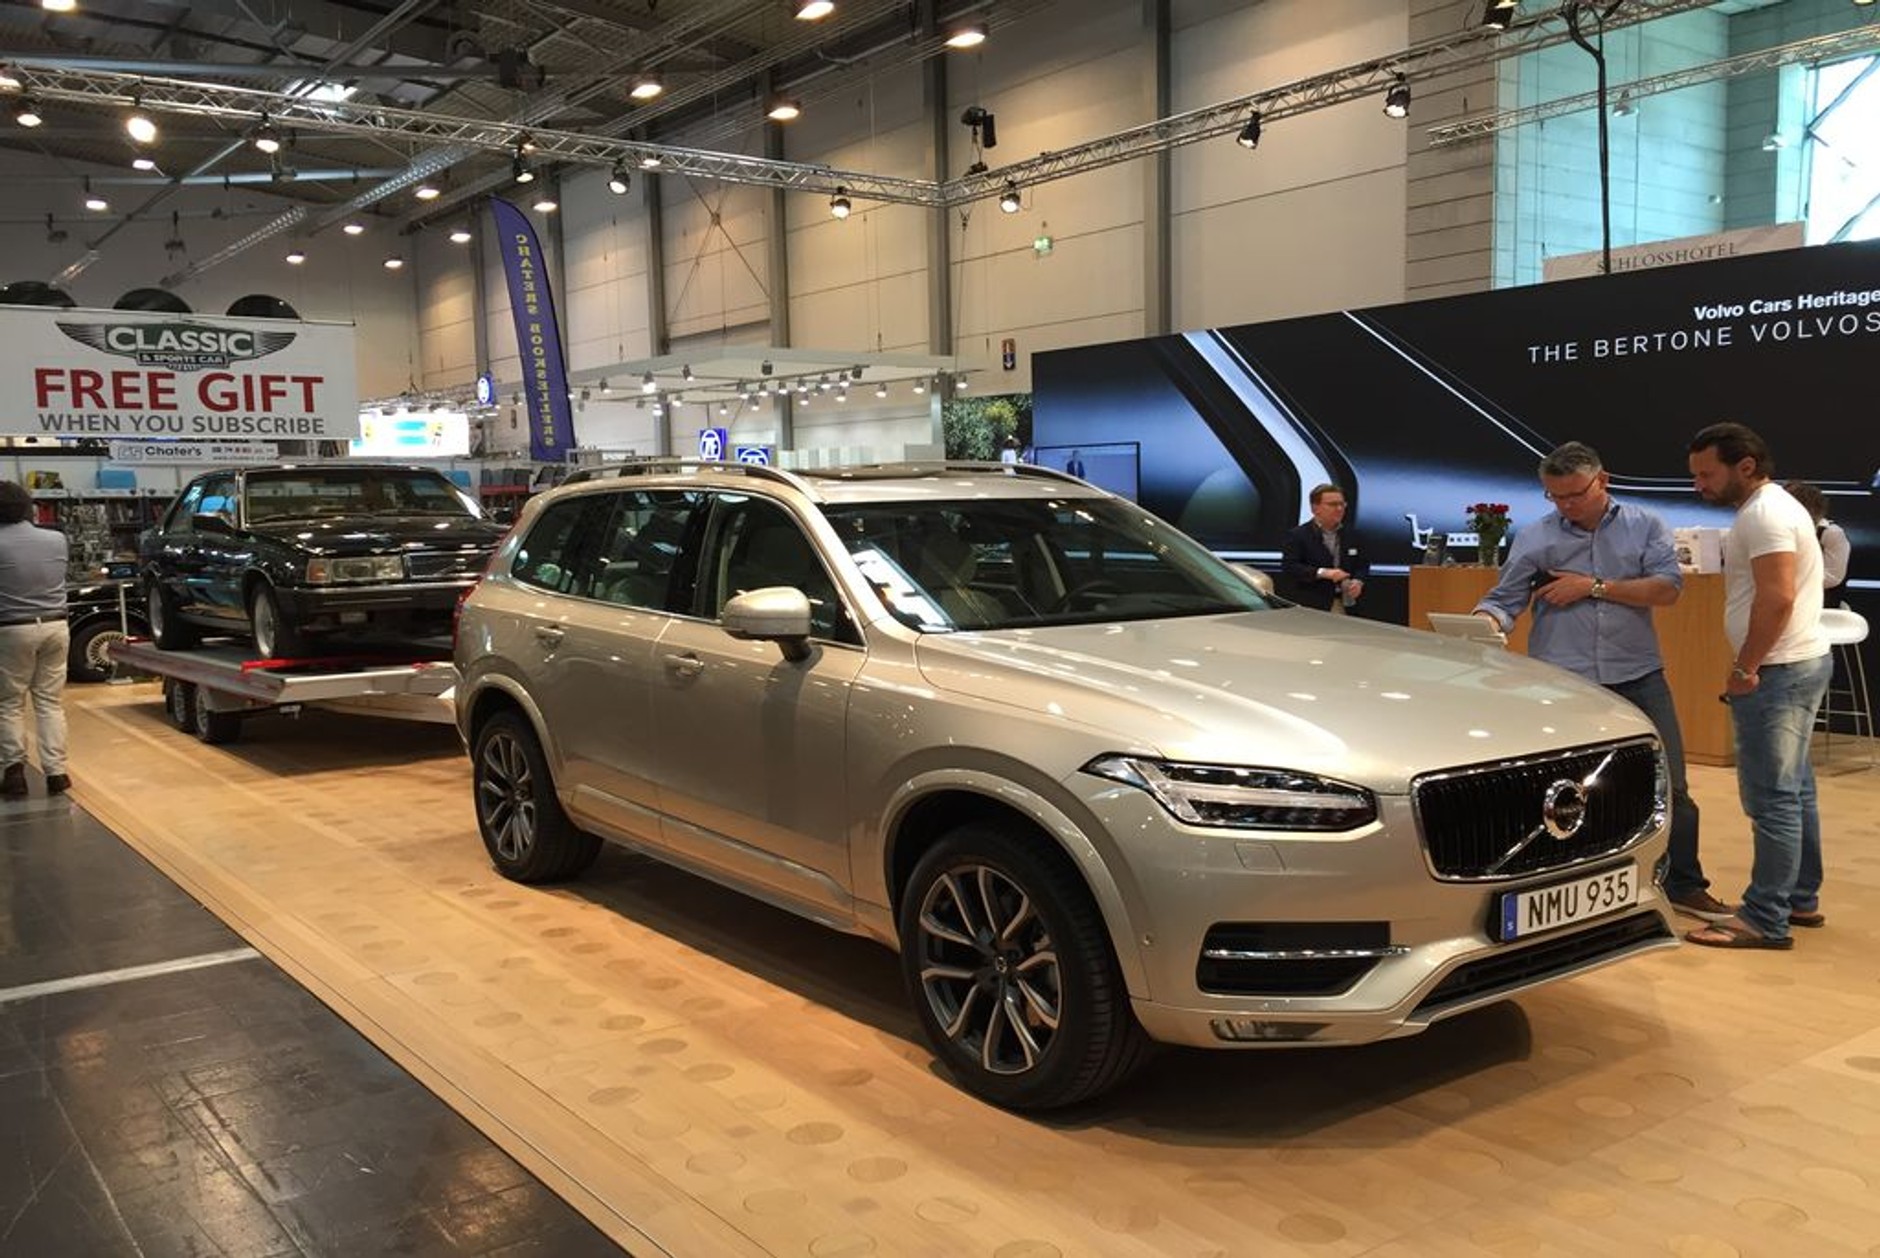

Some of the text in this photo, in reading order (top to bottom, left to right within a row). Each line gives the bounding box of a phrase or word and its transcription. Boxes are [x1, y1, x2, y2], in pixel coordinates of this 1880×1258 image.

[1694, 289, 1880, 320] Volvo Cars Heritage
[107, 326, 253, 356] CLASSIC
[1528, 312, 1880, 363] THE BERTONE VOLVOS
[199, 356, 224, 364] CAR
[35, 368, 324, 413] FREE GIFT
[38, 413, 324, 434] WHEN YOU SUBSCRIBE
[145, 446, 202, 456] Chater's
[1528, 871, 1629, 928] NMU 935
